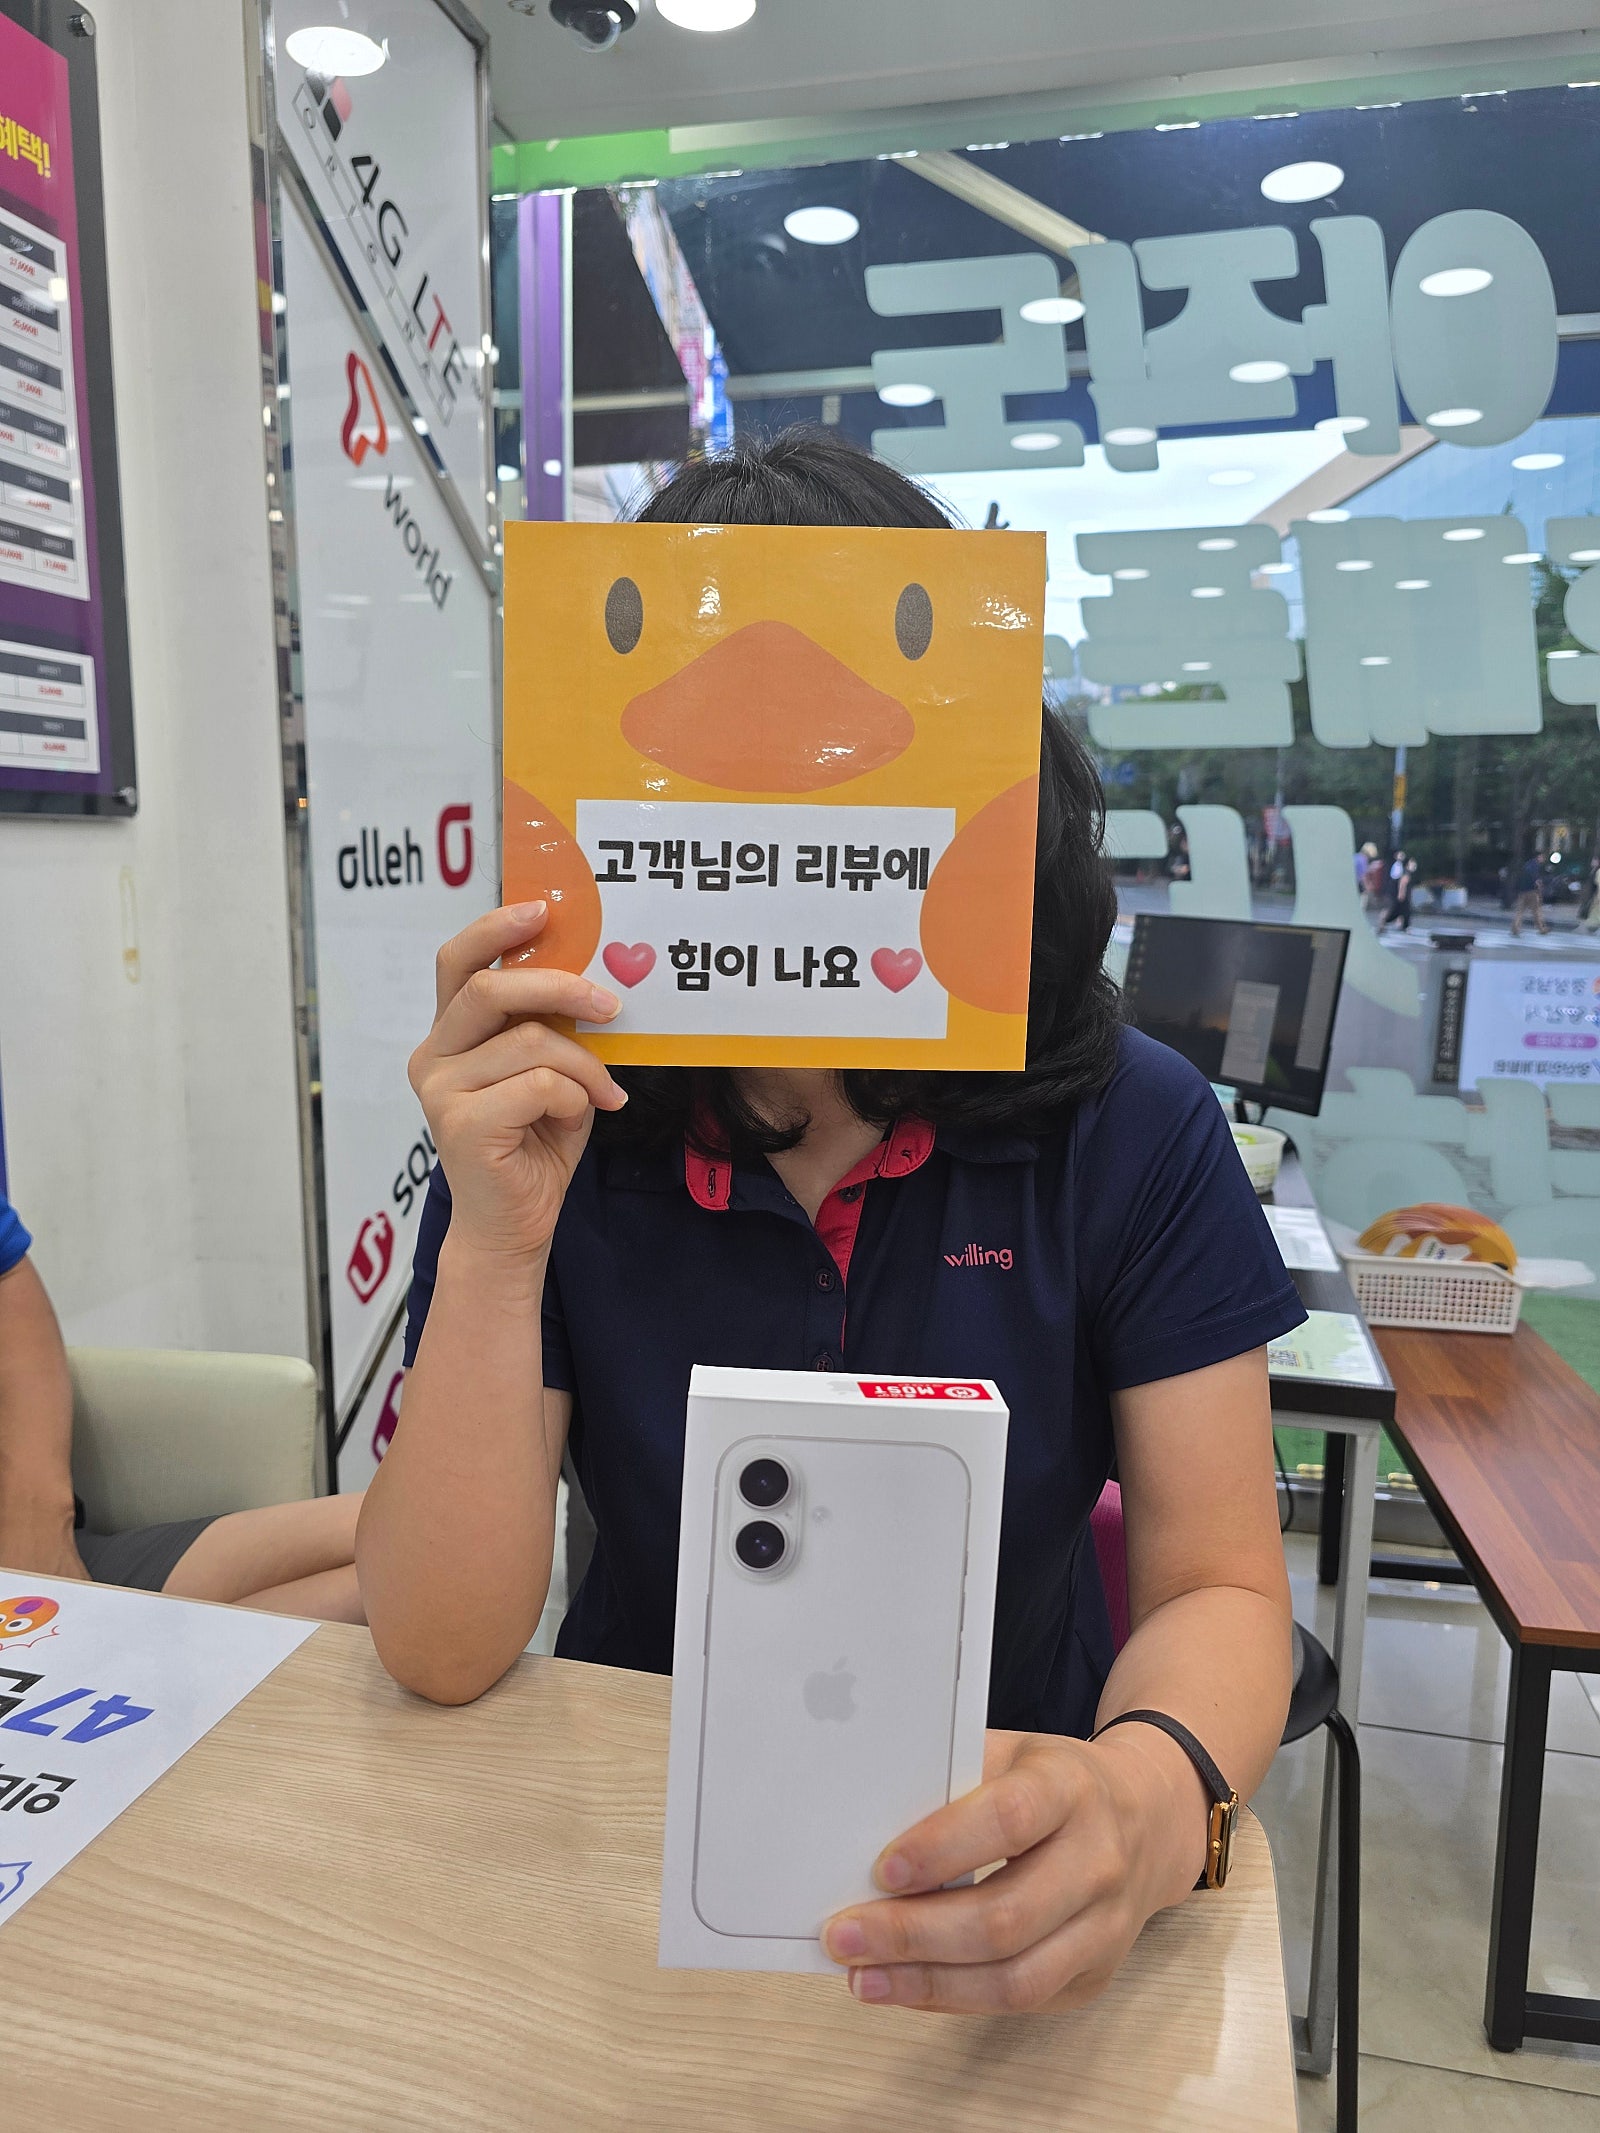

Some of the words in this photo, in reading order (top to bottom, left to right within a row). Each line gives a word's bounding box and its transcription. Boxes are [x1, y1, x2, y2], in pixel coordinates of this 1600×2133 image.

[351, 155, 409, 267] 4G
[412, 272, 468, 402] LTE
[384, 473, 453, 612] world
[338, 823, 424, 890] olleh
[595, 839, 780, 892] 고객님의
[796, 845, 931, 892] 리뷰에
[668, 938, 758, 991] 힘이
[774, 945, 861, 988] 나요
[943, 1243, 1014, 1270] willing
[874, 1384, 936, 1396] MOST
